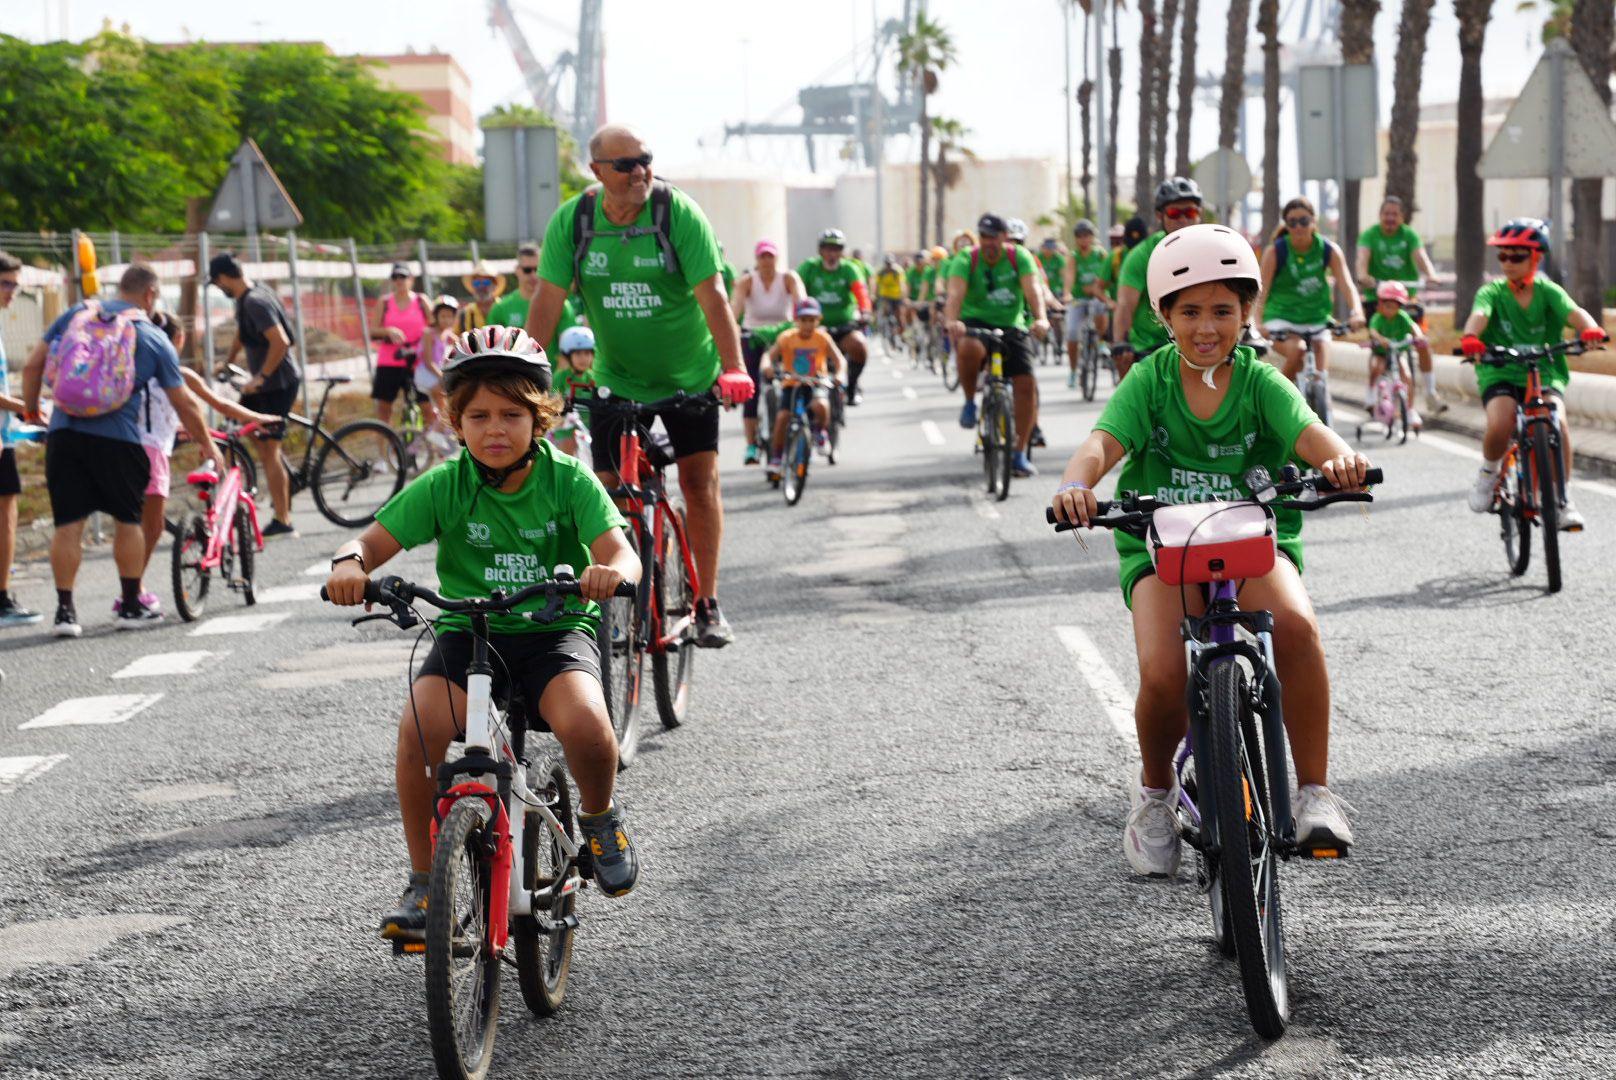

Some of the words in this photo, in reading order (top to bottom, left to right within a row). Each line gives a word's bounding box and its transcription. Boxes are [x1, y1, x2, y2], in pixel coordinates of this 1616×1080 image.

[587, 251, 608, 268] 30
[610, 282, 651, 295] FIESTA
[603, 295, 662, 309] BICICLETA
[1171, 467, 1232, 489] FIESTA
[467, 522, 490, 540] 30
[494, 553, 538, 567] FIESTA
